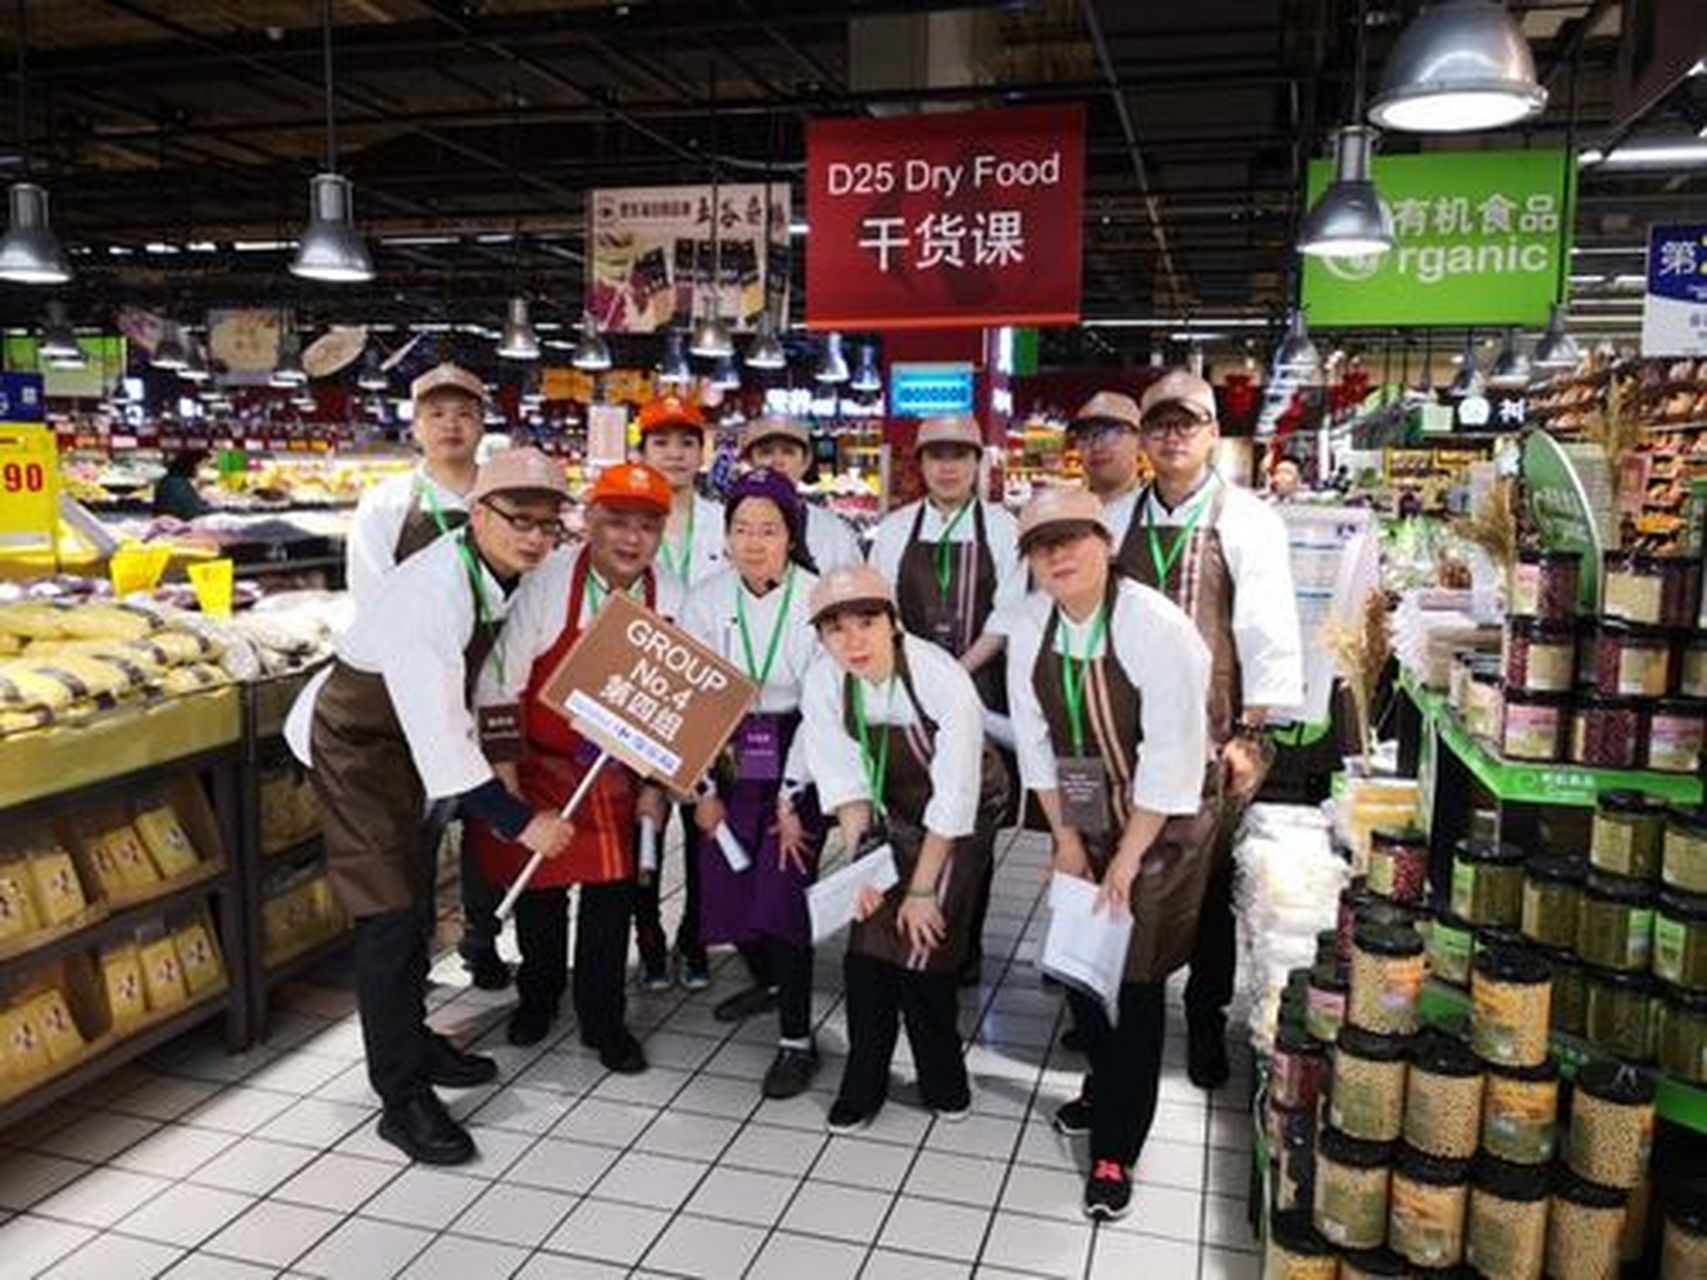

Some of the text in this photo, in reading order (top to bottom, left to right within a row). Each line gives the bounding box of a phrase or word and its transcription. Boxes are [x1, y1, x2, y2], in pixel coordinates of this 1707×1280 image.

[828, 151, 1060, 197] D25 Dry Food
[858, 210, 1025, 272] 干货课
[1392, 193, 1558, 238] 有机食品
[626, 619, 728, 692] GROUP
[630, 657, 694, 711] No.4
[600, 673, 685, 743] 第四组
